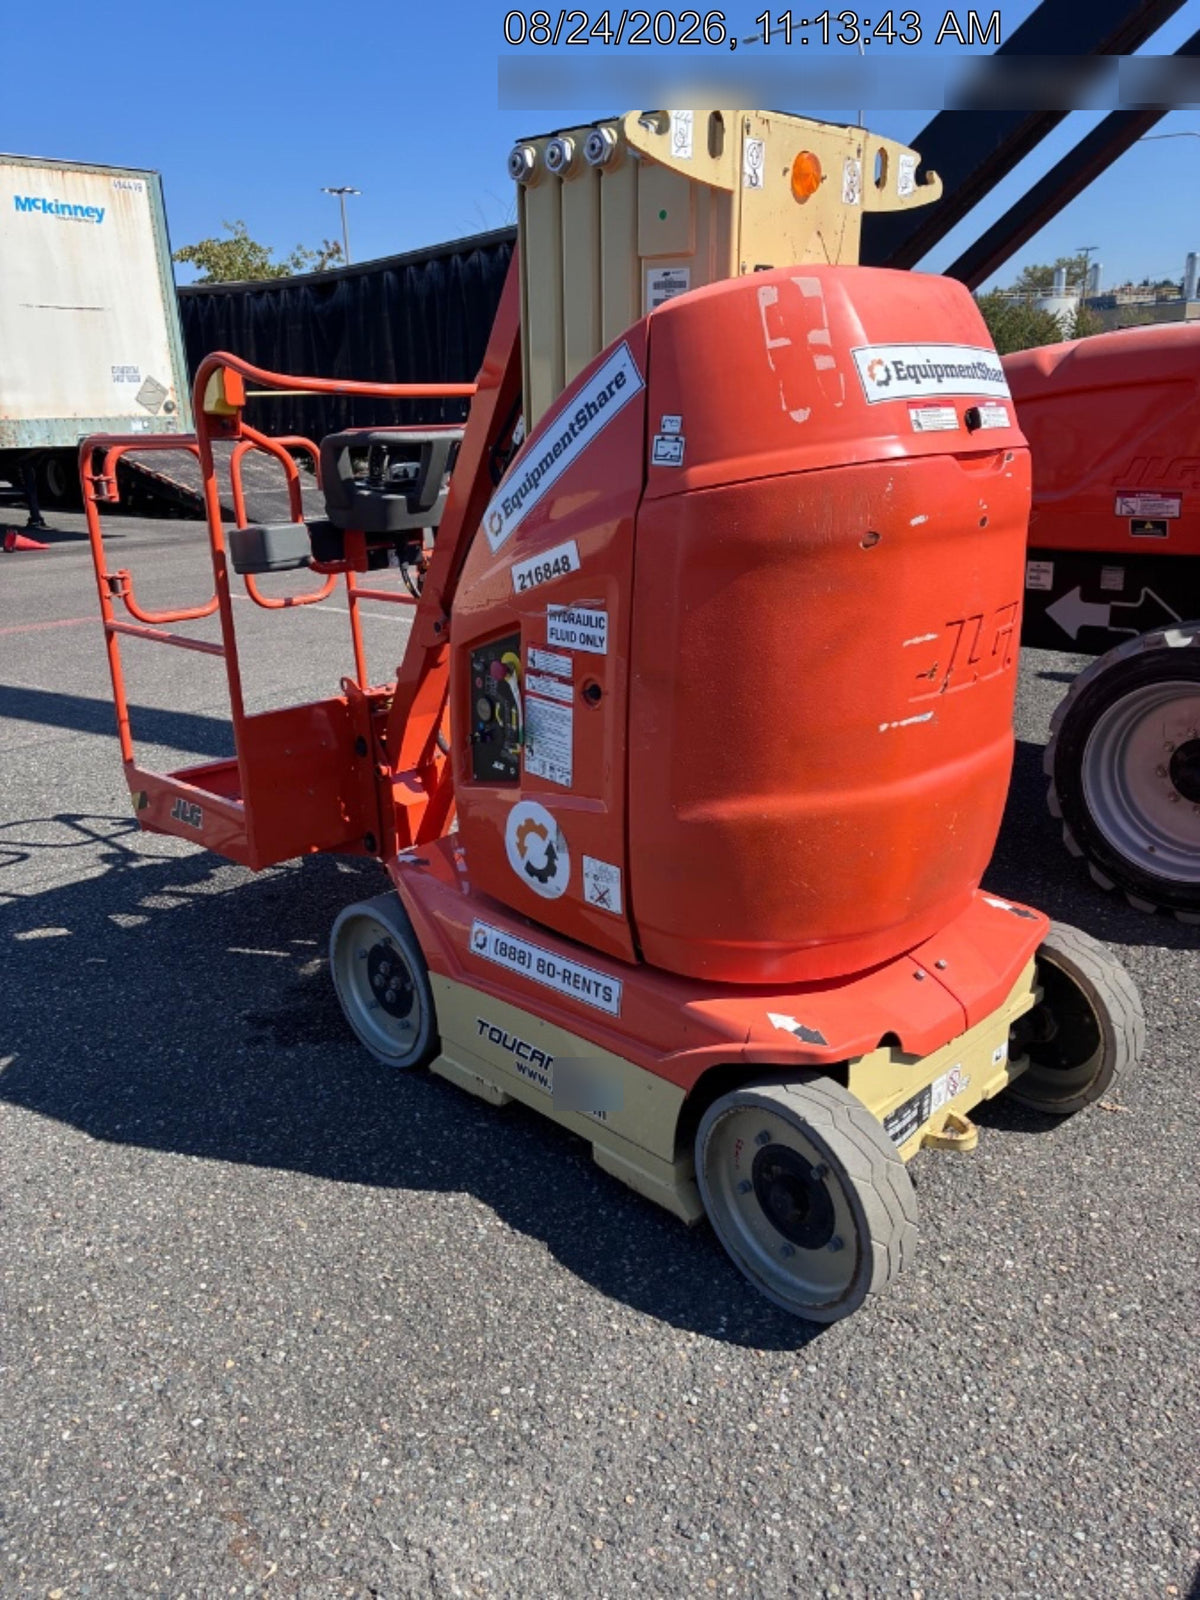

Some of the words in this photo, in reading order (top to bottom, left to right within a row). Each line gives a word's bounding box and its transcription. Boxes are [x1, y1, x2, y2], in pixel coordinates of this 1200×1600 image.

[501, 370, 628, 520] EquipmentShare
[518, 555, 571, 590] 216848
[548, 609, 606, 630] HYDRAULIC
[549, 627, 577, 643] FLUID
[579, 632, 605, 648] ONLY
[172, 798, 203, 830] JLG
[536, 957, 613, 1004] 80-RENTS
